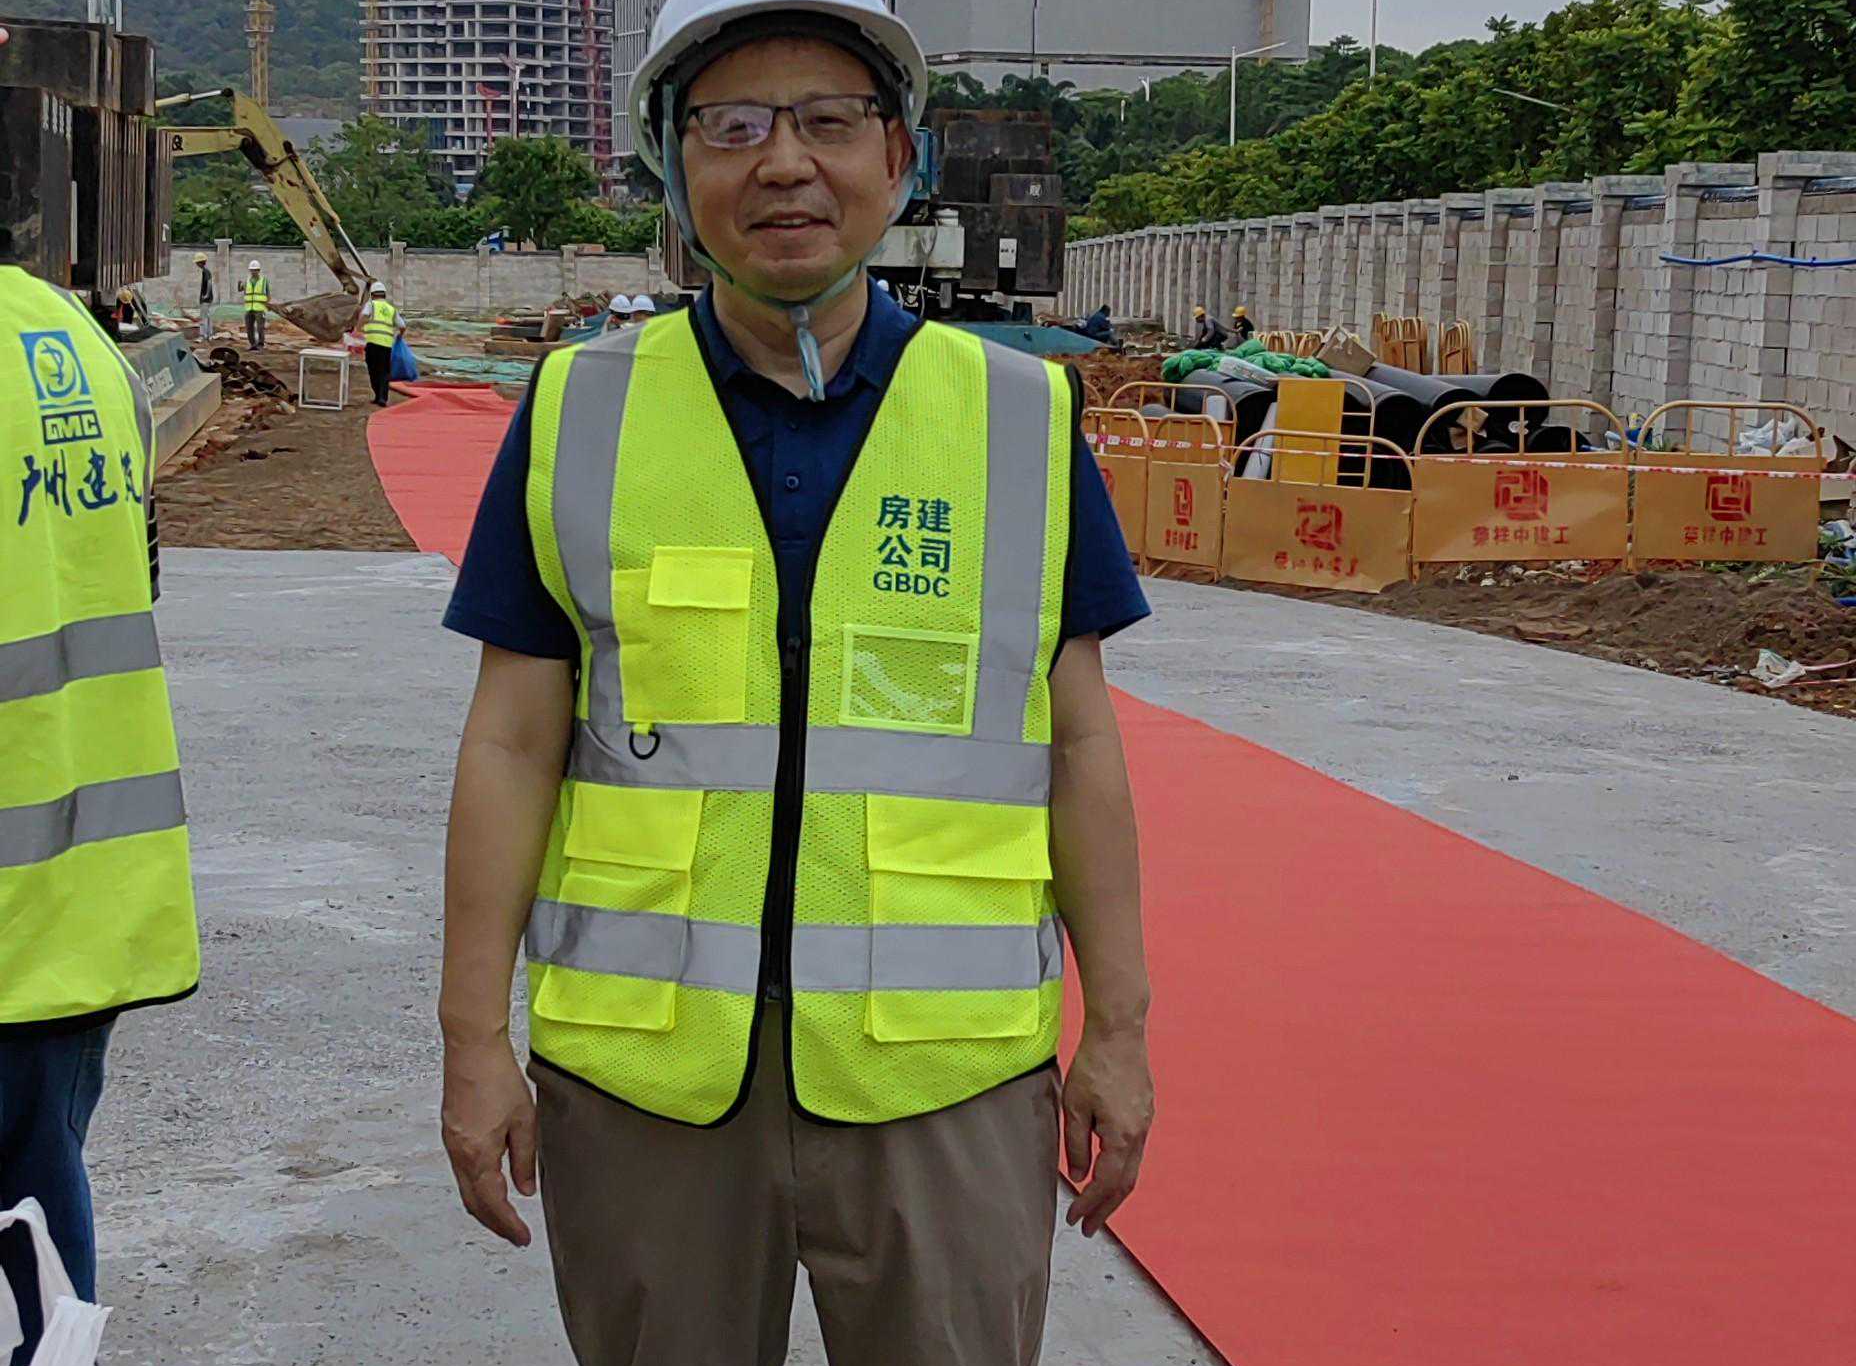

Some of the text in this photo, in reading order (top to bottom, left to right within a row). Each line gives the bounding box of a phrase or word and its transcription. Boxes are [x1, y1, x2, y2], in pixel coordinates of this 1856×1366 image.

[877, 495, 952, 533] 房建
[877, 534, 951, 573] 公司
[873, 571, 951, 598] GBDC
